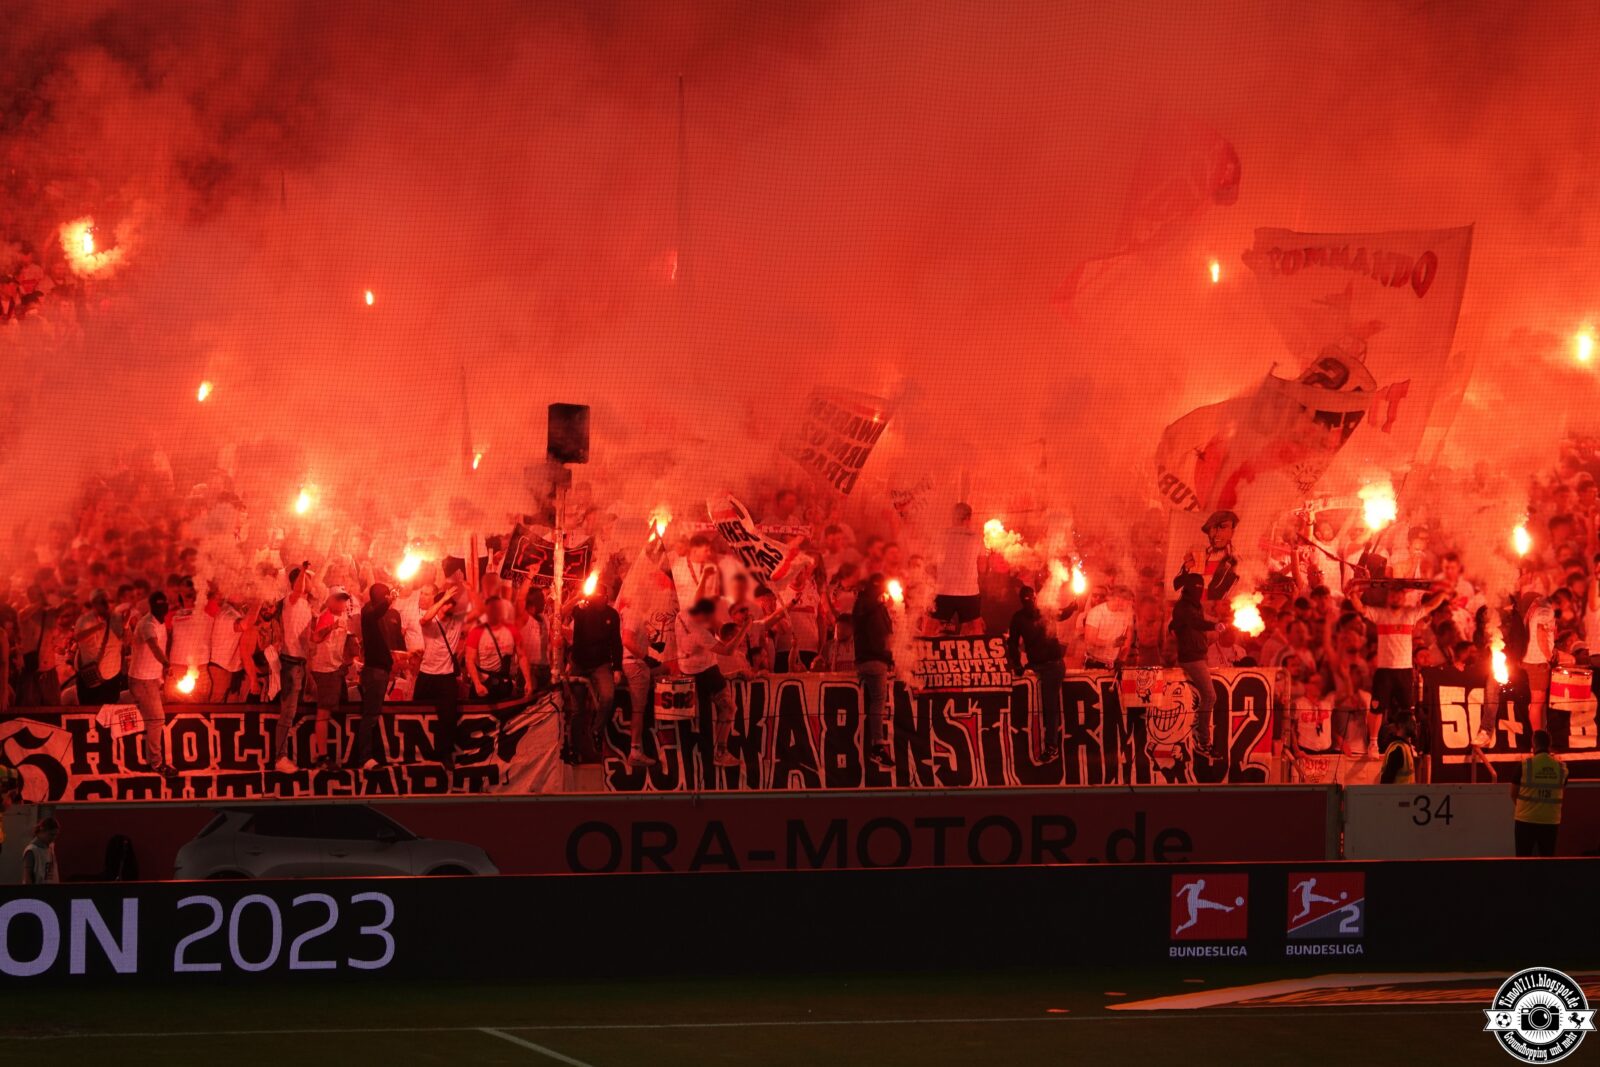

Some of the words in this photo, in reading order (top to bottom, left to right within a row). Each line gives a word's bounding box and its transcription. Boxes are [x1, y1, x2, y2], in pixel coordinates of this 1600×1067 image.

[915, 658, 1008, 674] BEDEUTET
[1339, 903, 1361, 933] 2
[0, 897, 139, 977] ON
[173, 892, 396, 972] 2023
[1169, 946, 1247, 957] BUNDESLIGA
[1285, 944, 1364, 956] BUNDESLIGA
